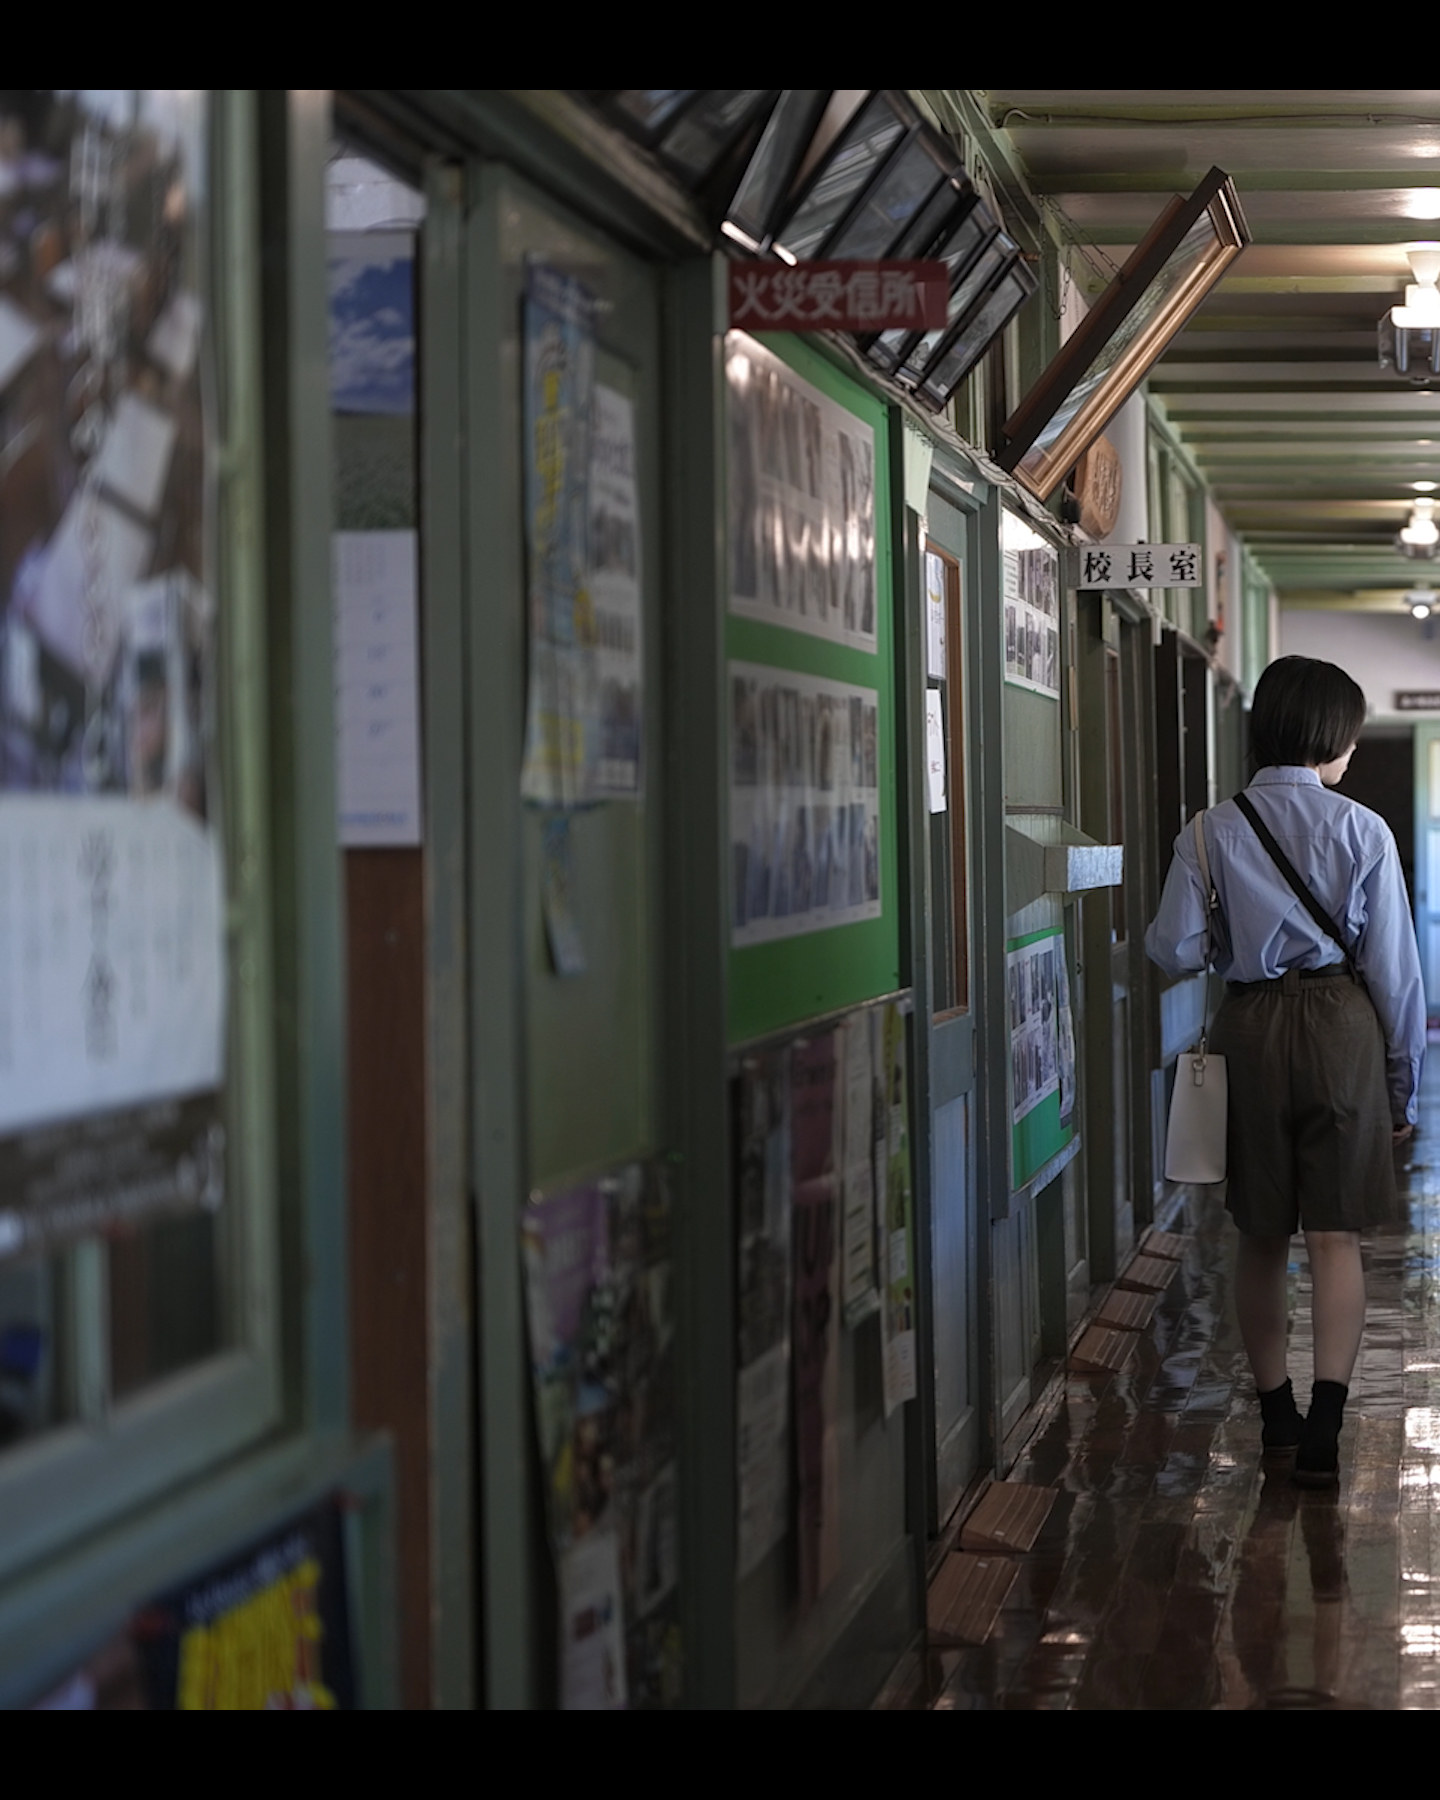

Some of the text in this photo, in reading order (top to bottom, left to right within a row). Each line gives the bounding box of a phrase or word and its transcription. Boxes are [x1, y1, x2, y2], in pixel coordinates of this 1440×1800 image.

[732, 269, 917, 320] 火災受信所
[1083, 550, 1197, 583] 校長室
